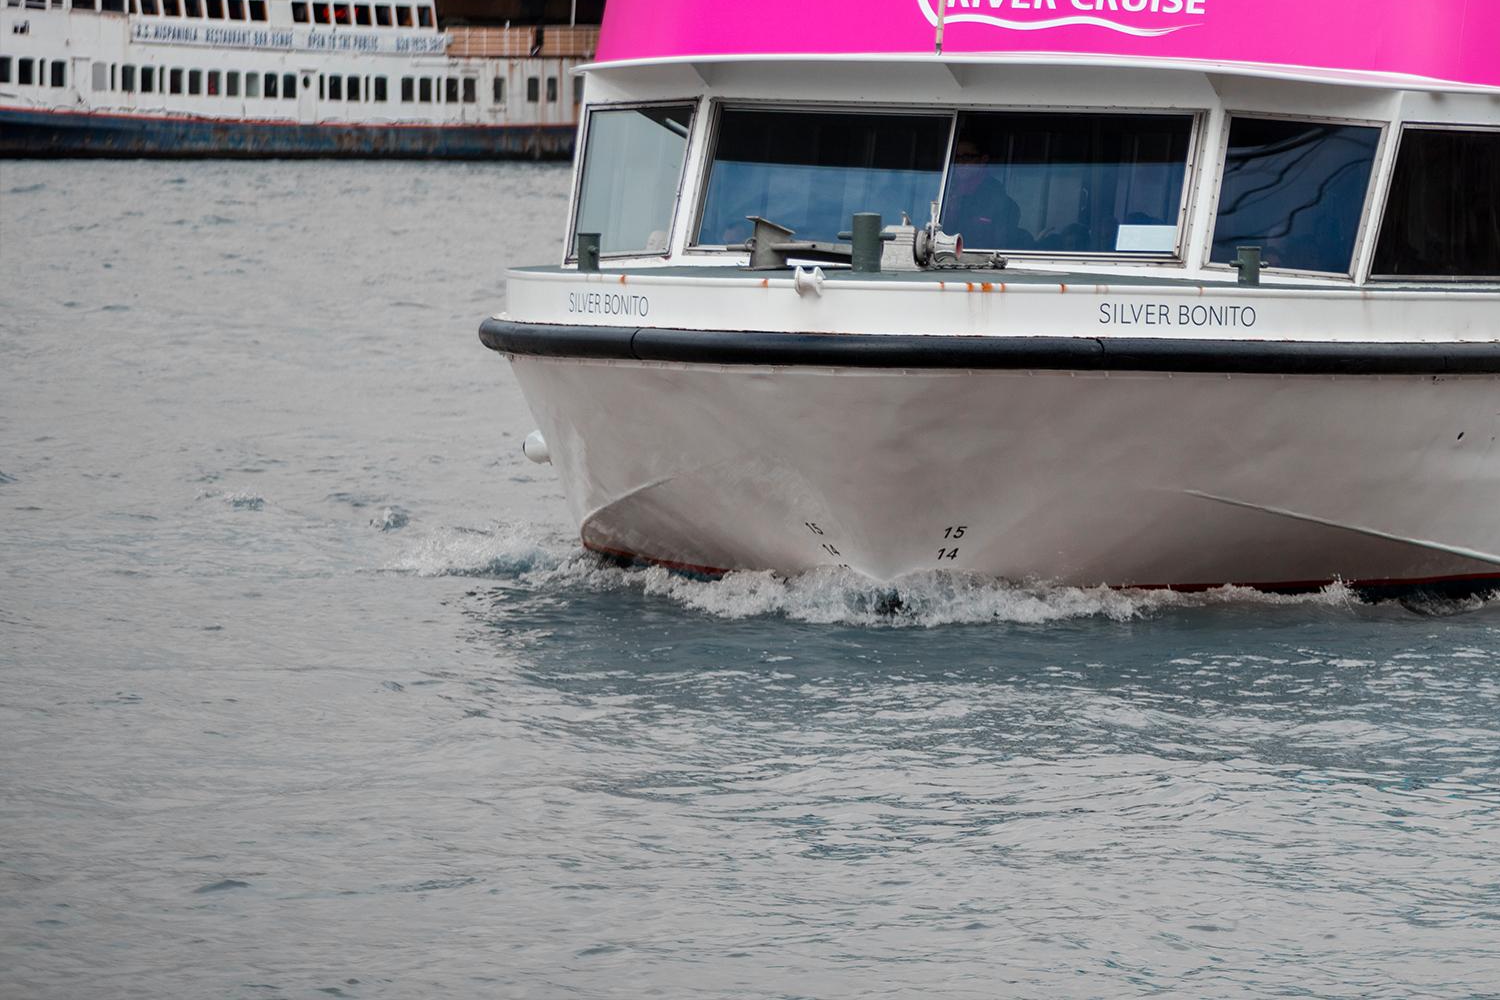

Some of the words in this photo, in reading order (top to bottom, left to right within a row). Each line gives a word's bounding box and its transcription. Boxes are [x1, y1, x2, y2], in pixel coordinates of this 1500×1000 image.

[568, 292, 601, 314] SILVER
[604, 293, 649, 317] BONITO
[1099, 302, 1171, 325] SILVER
[1178, 304, 1256, 327] BONITO
[805, 521, 823, 535] 15
[943, 525, 968, 539] 15
[937, 547, 959, 560] 14
